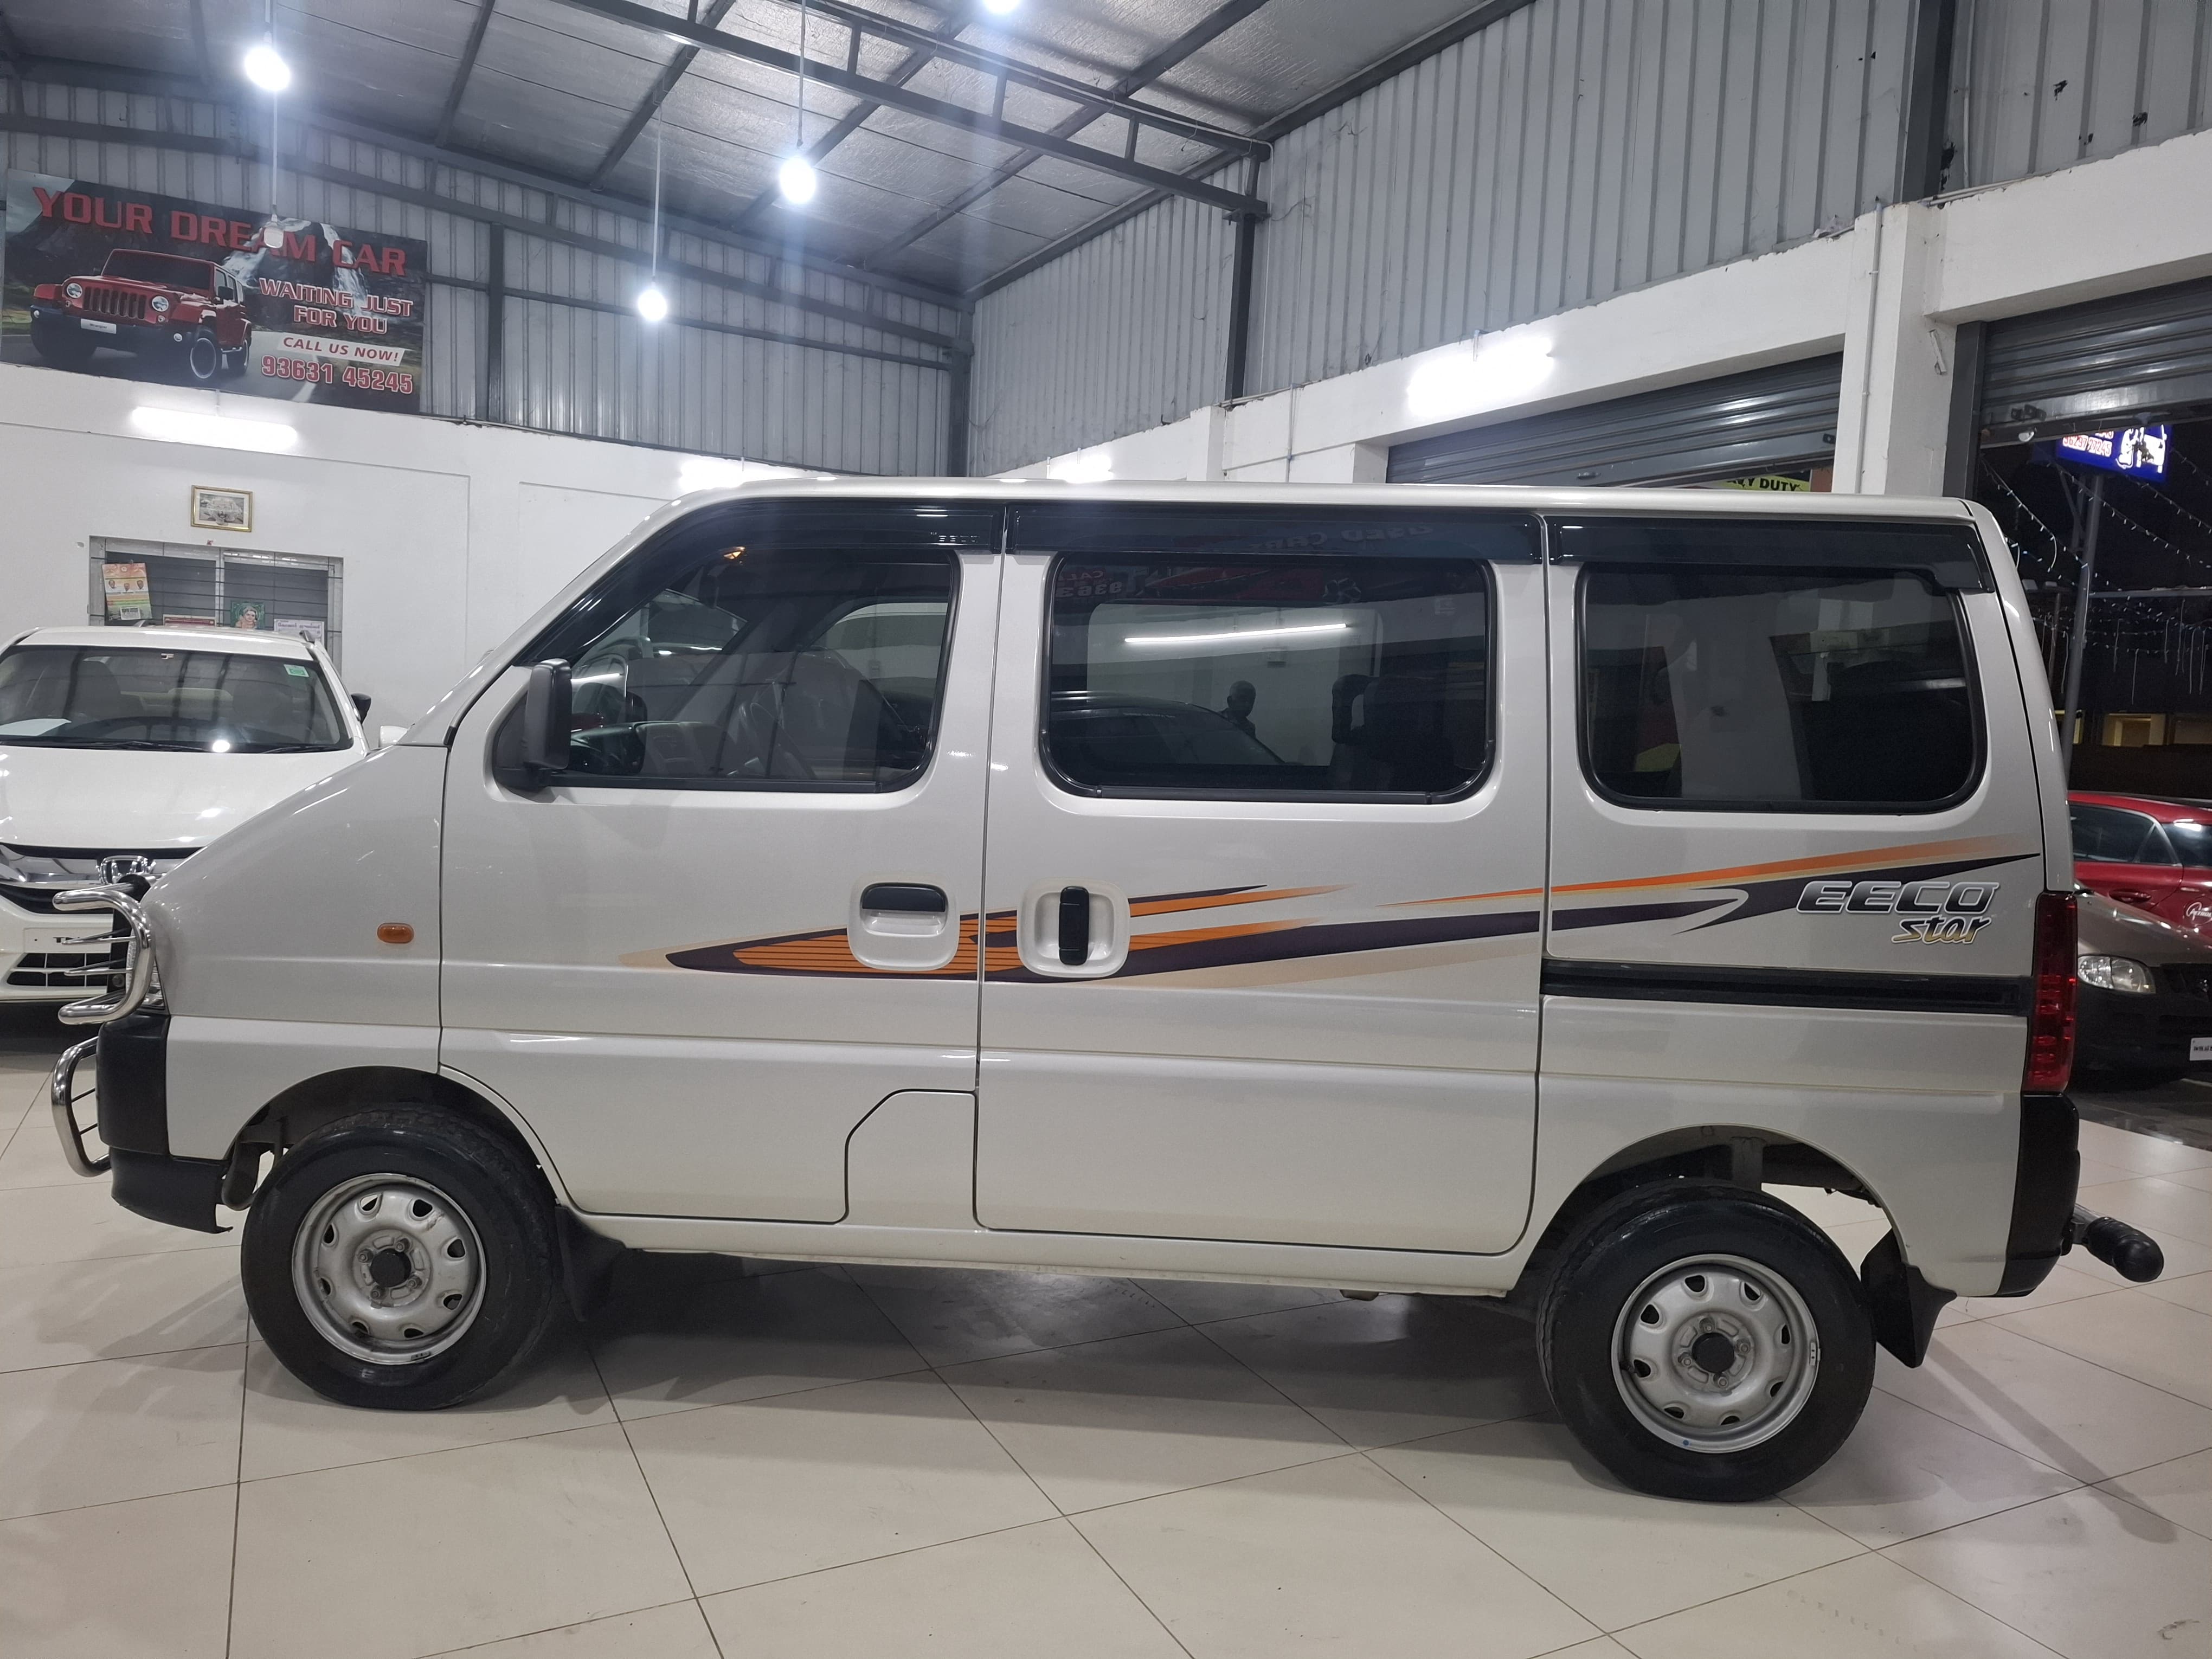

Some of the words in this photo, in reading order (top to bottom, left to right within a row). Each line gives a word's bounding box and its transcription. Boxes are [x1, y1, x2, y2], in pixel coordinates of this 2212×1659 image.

[33, 187, 152, 234] YOUR
[332, 239, 406, 277] CAR
[259, 277, 353, 308] WAITING
[361, 294, 414, 317] JUST
[294, 305, 337, 327] FOR
[343, 313, 388, 335] YOU
[283, 337, 322, 352] CALL
[329, 343, 349, 355] US
[354, 347, 398, 362] NOW!
[261, 355, 333, 384] 93631
[342, 366, 413, 394] 45245
[1796, 880, 2000, 914] EECO
